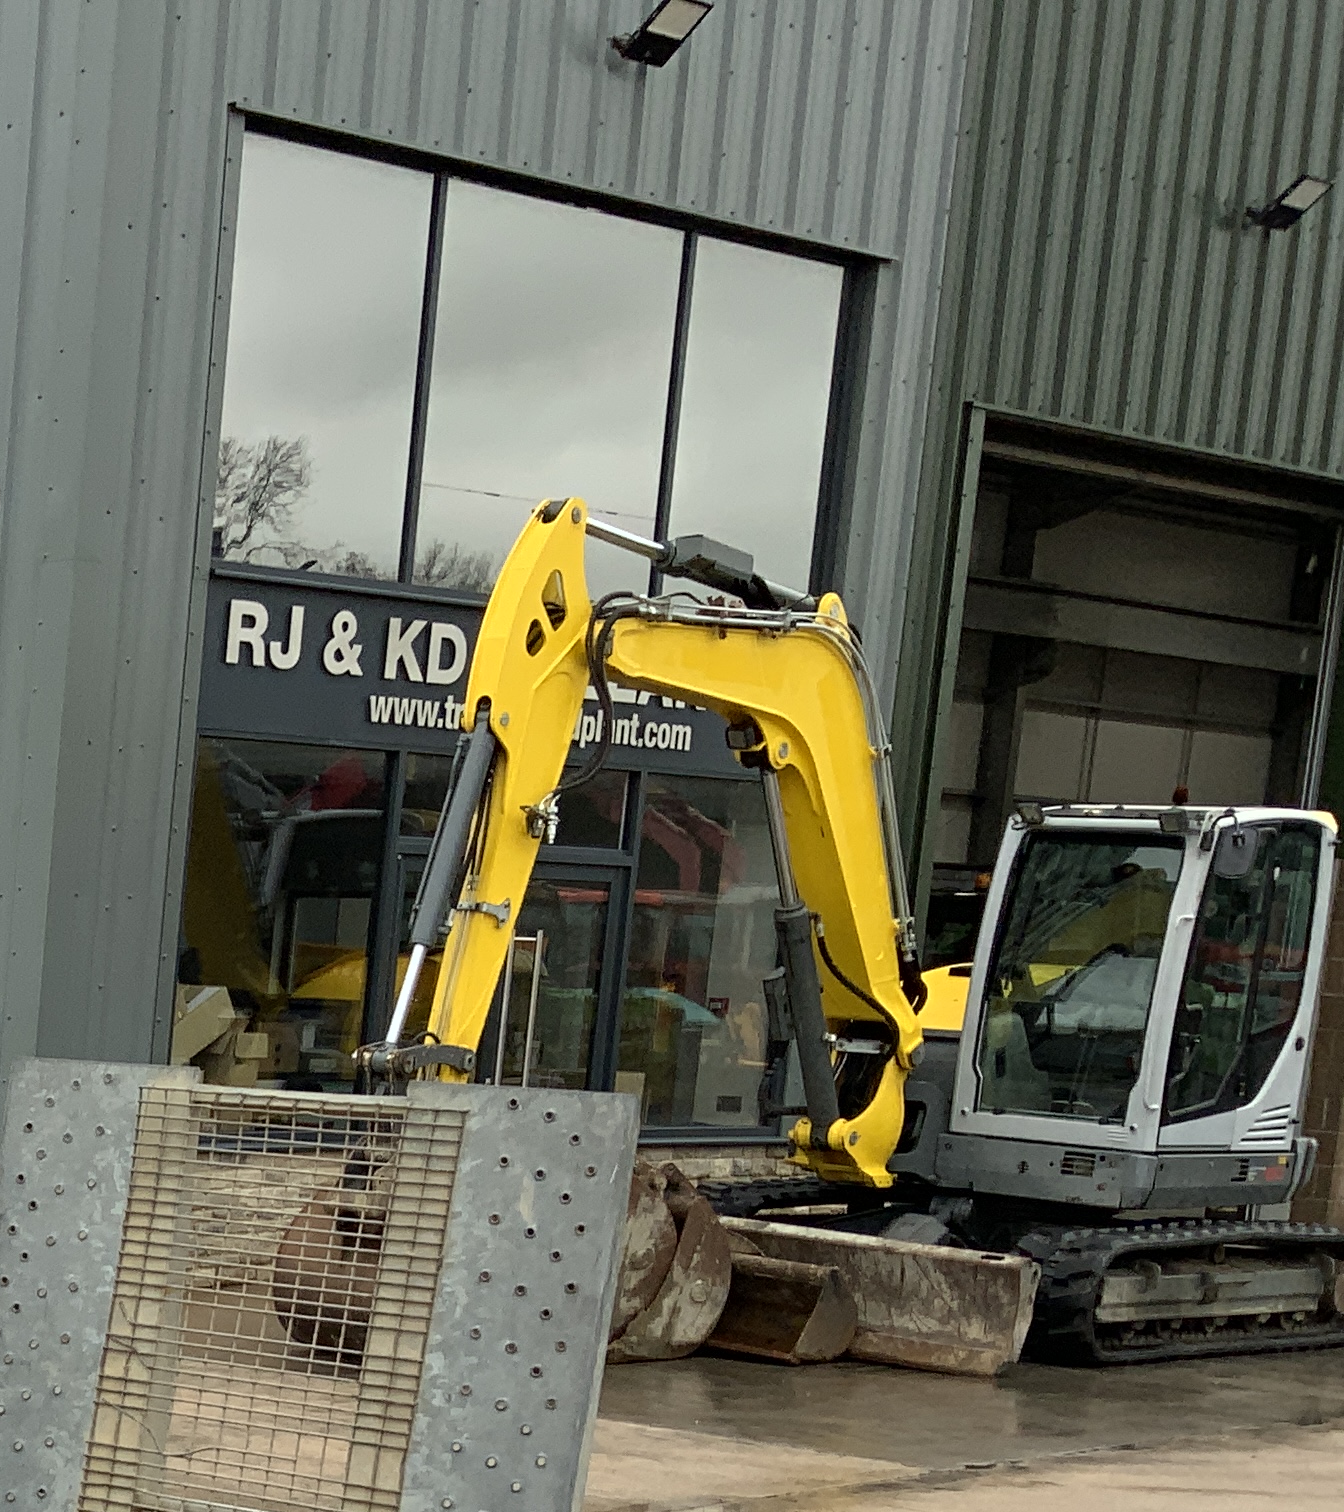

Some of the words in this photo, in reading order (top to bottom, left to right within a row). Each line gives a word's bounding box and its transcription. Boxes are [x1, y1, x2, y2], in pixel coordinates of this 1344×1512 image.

[225, 599, 305, 670] RJ
[323, 609, 363, 676] &
[384, 617, 467, 685] KD
